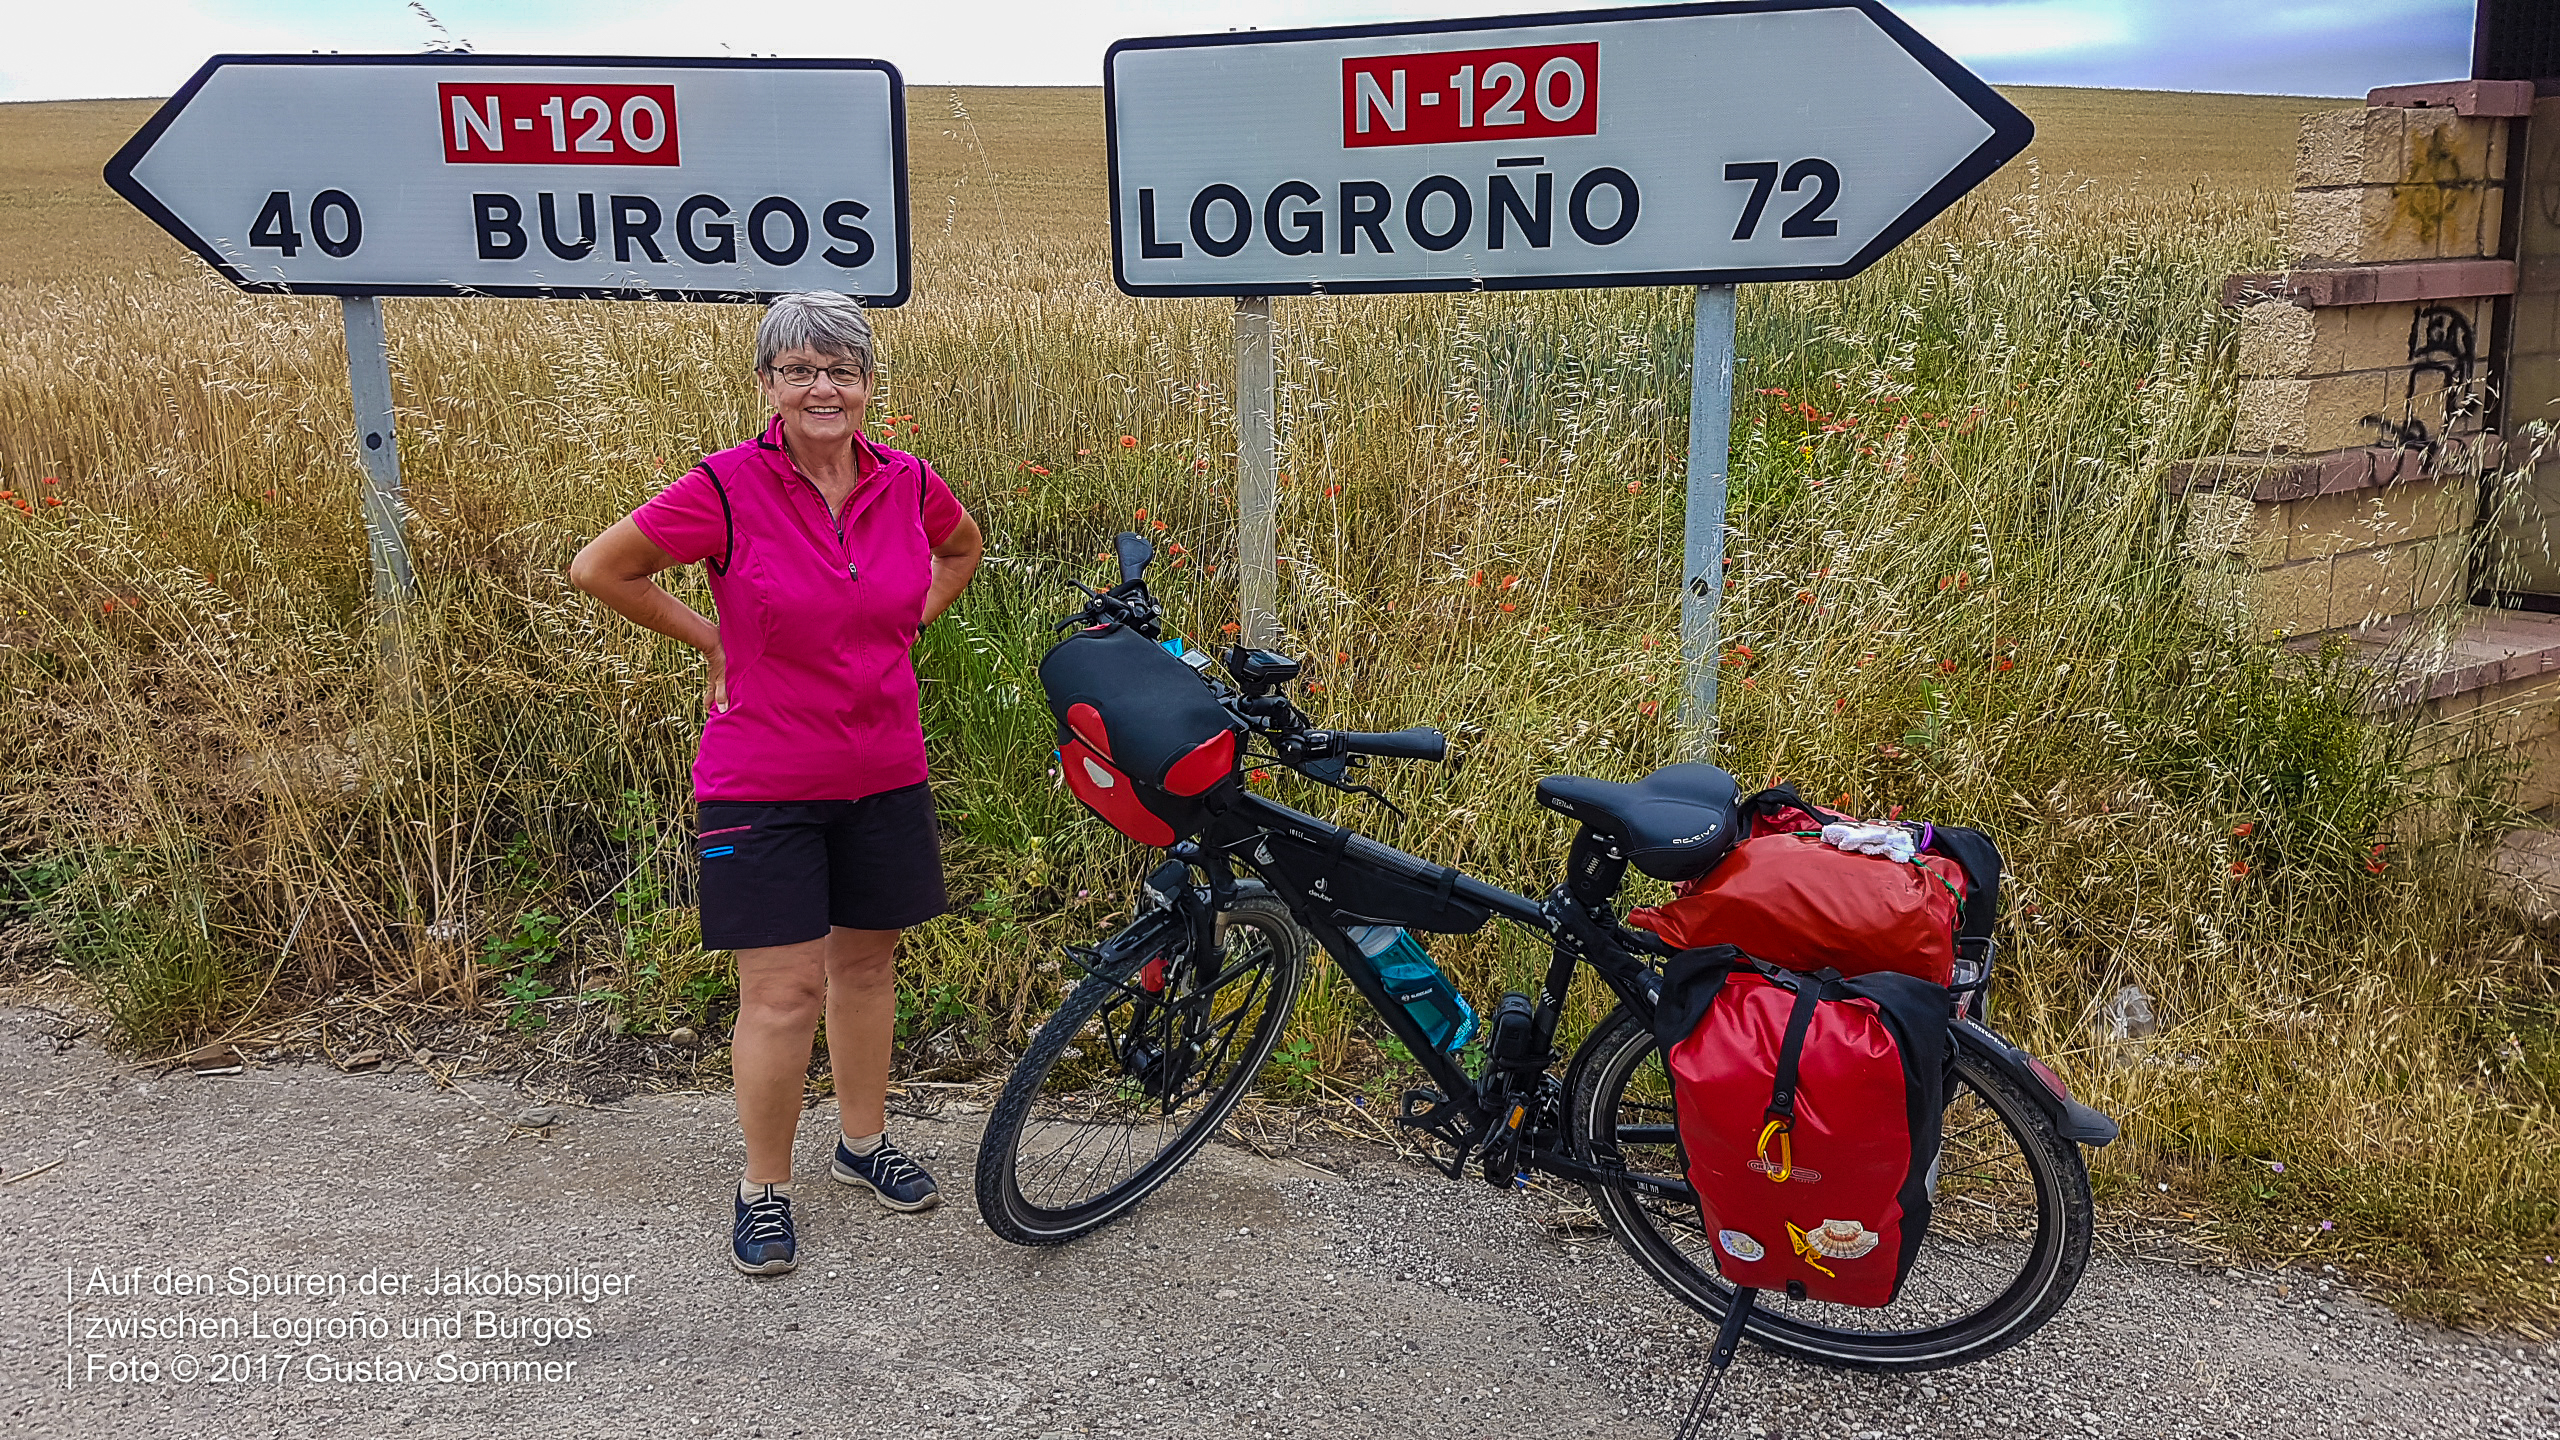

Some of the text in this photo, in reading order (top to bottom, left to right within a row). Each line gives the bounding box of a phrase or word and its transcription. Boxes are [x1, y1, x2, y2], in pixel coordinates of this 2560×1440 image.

[451, 95, 666, 153] N-120
[1355, 56, 1586, 134] N-120
[248, 190, 876, 269] 40 BURGOS
[1138, 156, 1841, 260] LOGROÑO 72
